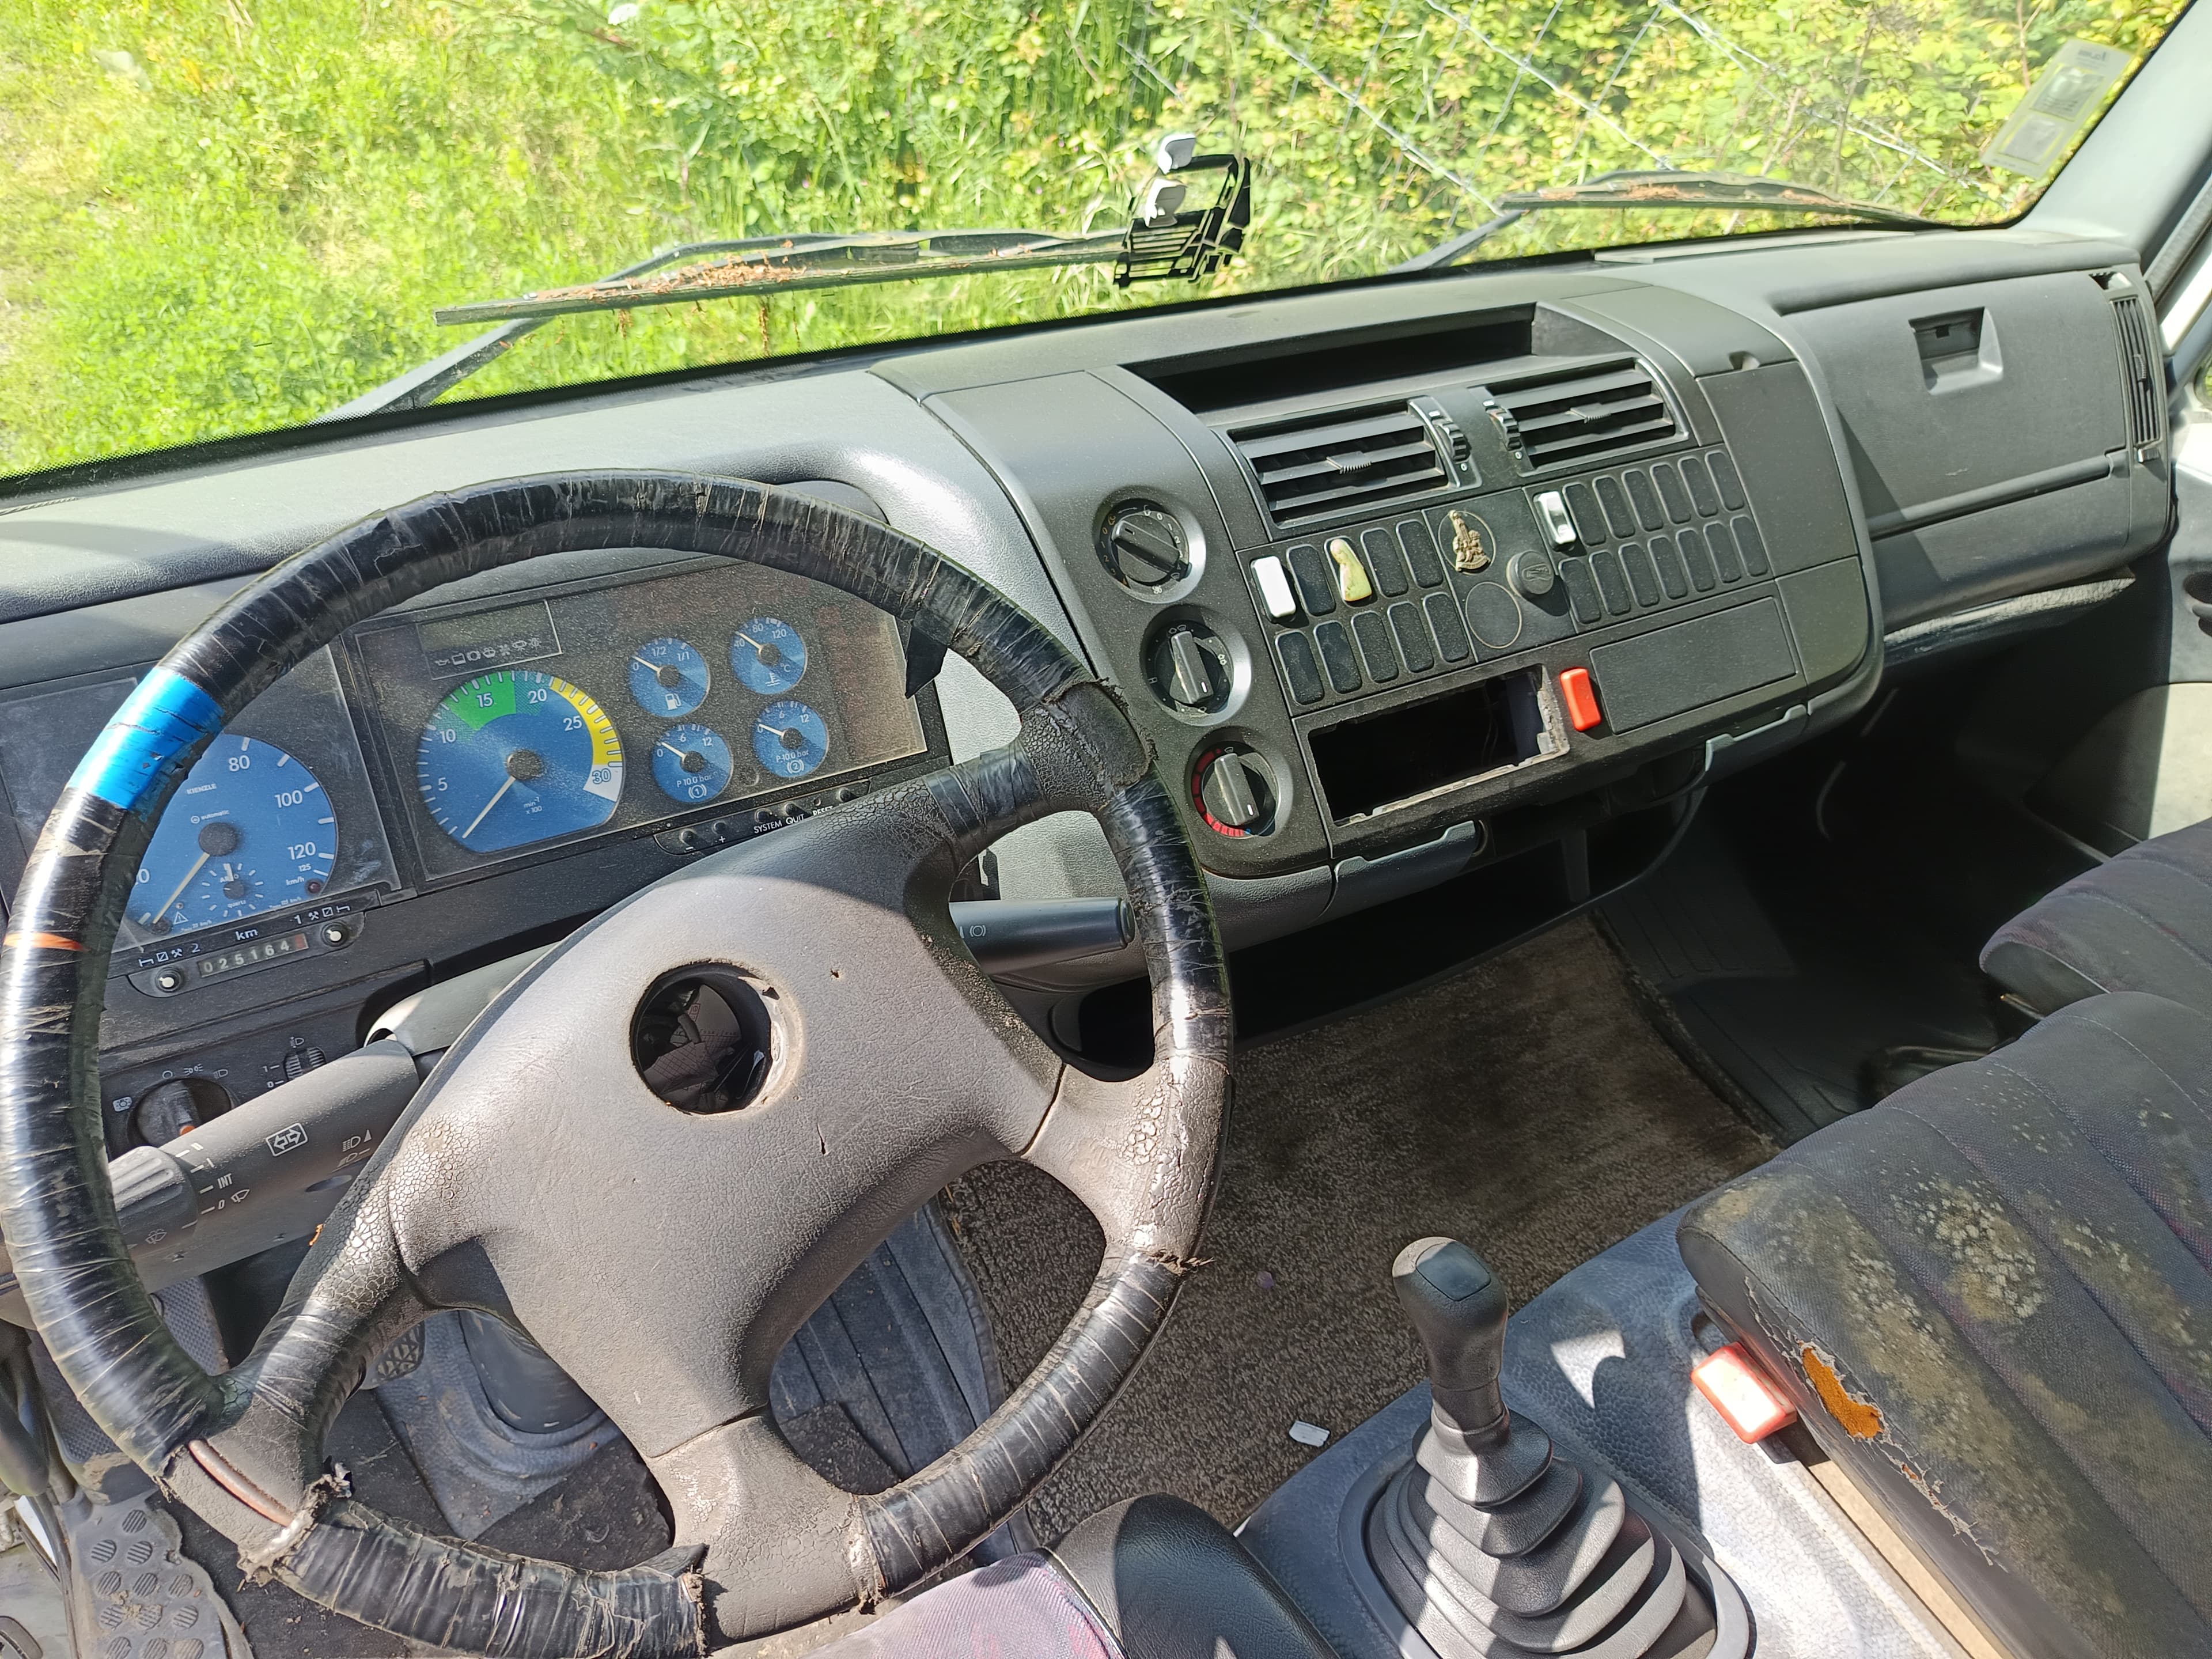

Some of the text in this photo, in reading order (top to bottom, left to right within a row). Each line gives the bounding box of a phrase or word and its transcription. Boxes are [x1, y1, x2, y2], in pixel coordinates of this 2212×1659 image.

[1173, 536, 1181, 544] 2
[752, 623, 764, 633] 80
[771, 628, 787, 640] 120
[734, 638, 745, 648] 40
[652, 646, 667, 658] 1/2
[677, 650, 690, 662] 1/1
[632, 662, 639, 671] 0
[476, 693, 494, 708] 15
[528, 688, 548, 704] 20
[779, 711, 785, 719] 6
[800, 713, 810, 724] 12
[563, 715, 582, 732] 25
[439, 728, 457, 744] 10
[679, 733, 687, 743] 6
[702, 737, 713, 747] 12
[656, 748, 664, 758] 0
[797, 749, 809, 757] bar
[228, 755, 251, 772] 80
[592, 769, 611, 784] 30
[186, 783, 217, 795] KIENZLE
[437, 778, 448, 791] 5
[676, 779, 681, 789] P
[274, 790, 303, 808] 100
[530, 805, 543, 813] 100
[200, 810, 229, 820] automatic
[753, 820, 782, 834] SYSTEM
[786, 813, 805, 825] QUIT
[288, 842, 316, 860] 120
[298, 863, 312, 872] 125
[135, 868, 150, 885] 0
[286, 876, 305, 886] km/h
[228, 900, 247, 908] quartz
[294, 915, 302, 925] 1
[236, 928, 259, 941] km
[192, 943, 201, 953] 2
[217, 1173, 233, 1190] INT
